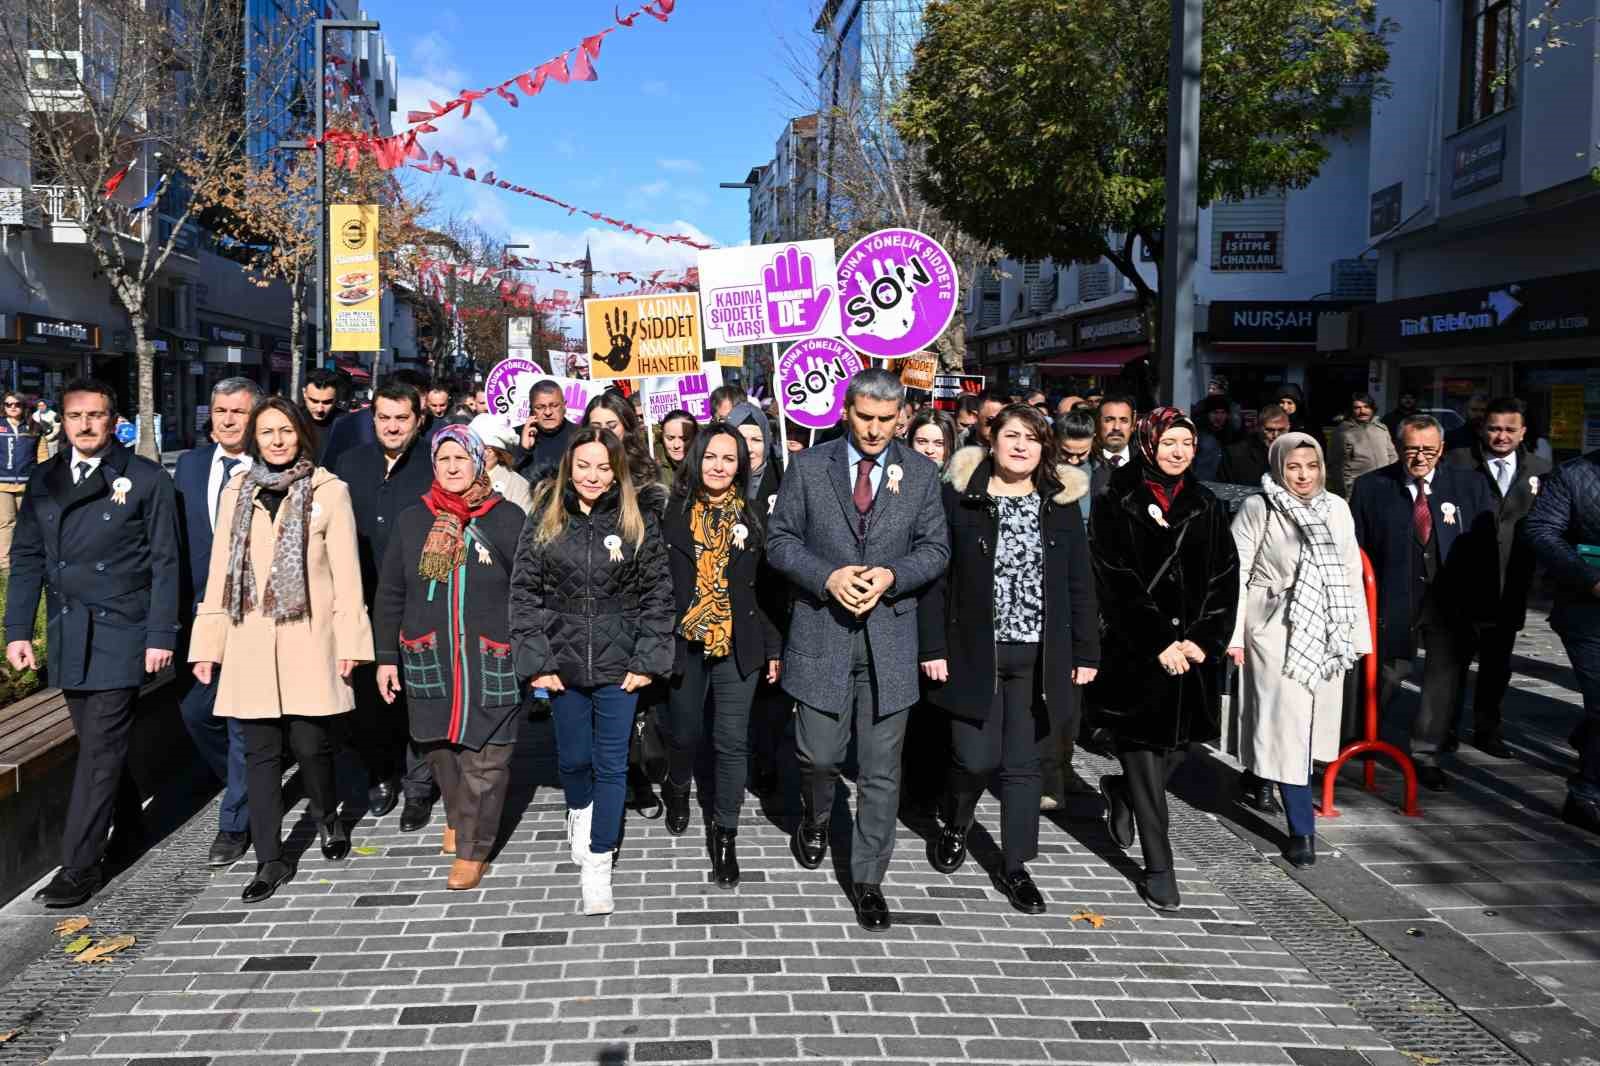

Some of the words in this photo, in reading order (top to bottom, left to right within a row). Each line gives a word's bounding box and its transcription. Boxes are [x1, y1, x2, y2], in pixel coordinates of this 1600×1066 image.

[838, 249, 866, 296] KADINA
[864, 235, 924, 253] YÖNELİK
[922, 246, 952, 300] ŞİDDETE
[715, 289, 762, 307] KADINA
[847, 257, 931, 328] SON
[777, 299, 807, 328] DE
[1234, 310, 1312, 330] NURŞAH
[728, 320, 765, 339] KARŞI
[801, 340, 844, 355] YÖNELİK
[637, 352, 699, 375] İHANETTİR
[788, 358, 847, 405] SON
